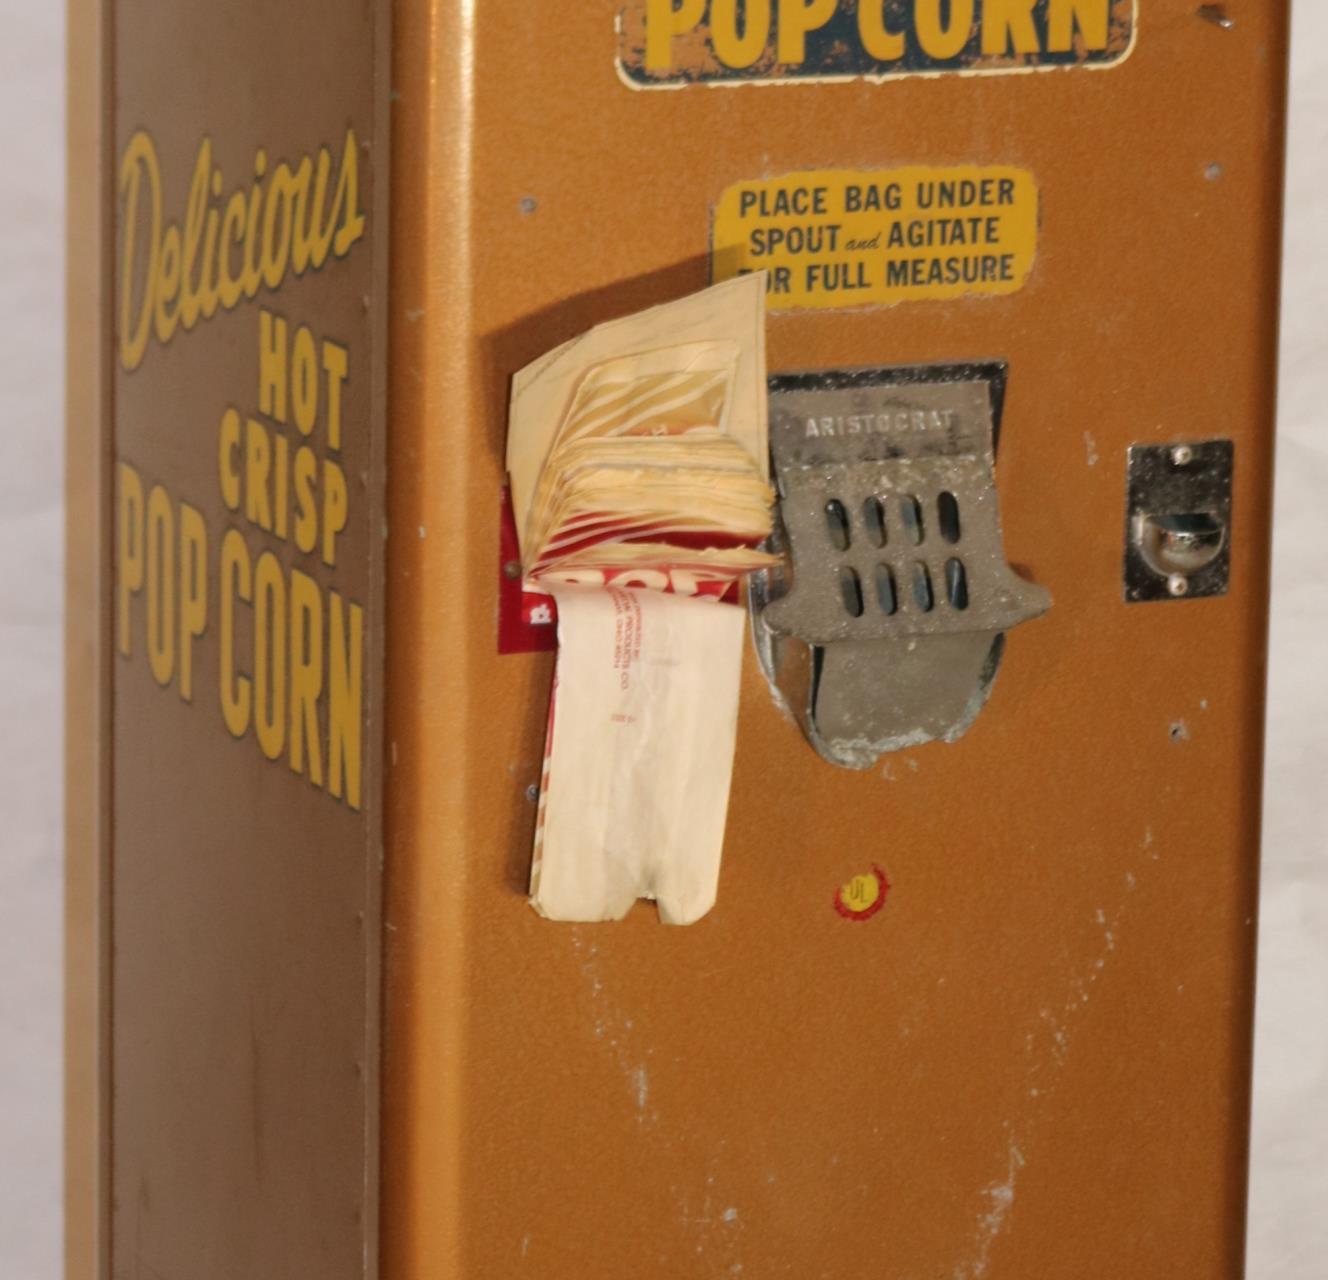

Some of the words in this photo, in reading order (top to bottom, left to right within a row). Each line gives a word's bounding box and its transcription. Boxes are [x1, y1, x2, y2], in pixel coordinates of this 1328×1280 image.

[739, 186, 829, 219] PLACE
[844, 182, 902, 214] BAG
[916, 178, 1016, 210] UNDER
[749, 223, 842, 257] SPOUT
[844, 231, 882, 251] and
[886, 216, 1001, 250] AGITATE
[117, 129, 366, 372] Delicious
[805, 261, 873, 293] FULL
[886, 253, 1016, 288] MEASURE
[258, 308, 350, 452] HOT
[804, 409, 954, 439] ARISTOCRAT
[219, 407, 349, 567] CRISP
[117, 460, 209, 703] POP
[219, 528, 364, 813] CORN
